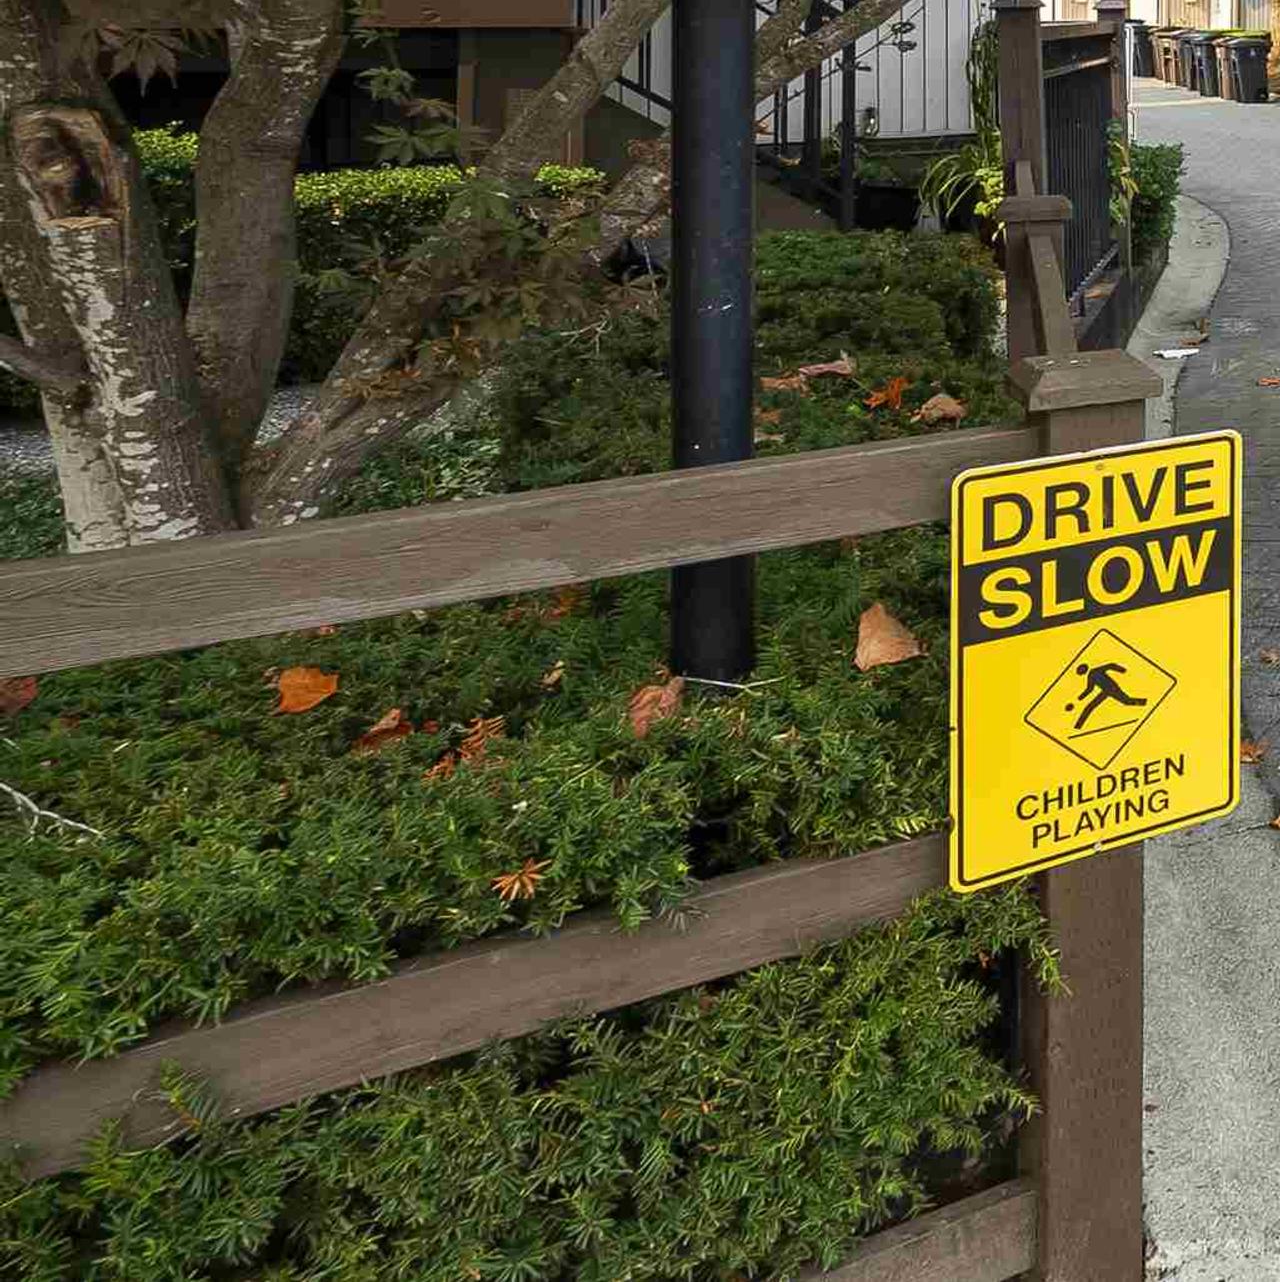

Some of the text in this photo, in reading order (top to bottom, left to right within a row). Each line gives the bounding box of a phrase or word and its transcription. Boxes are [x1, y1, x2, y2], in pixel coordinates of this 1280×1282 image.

[981, 459, 1215, 552] DRIVE
[979, 529, 1218, 630] SLOW
[1016, 753, 1186, 821] CHILDREN
[1032, 789, 1170, 849] PLAYING
